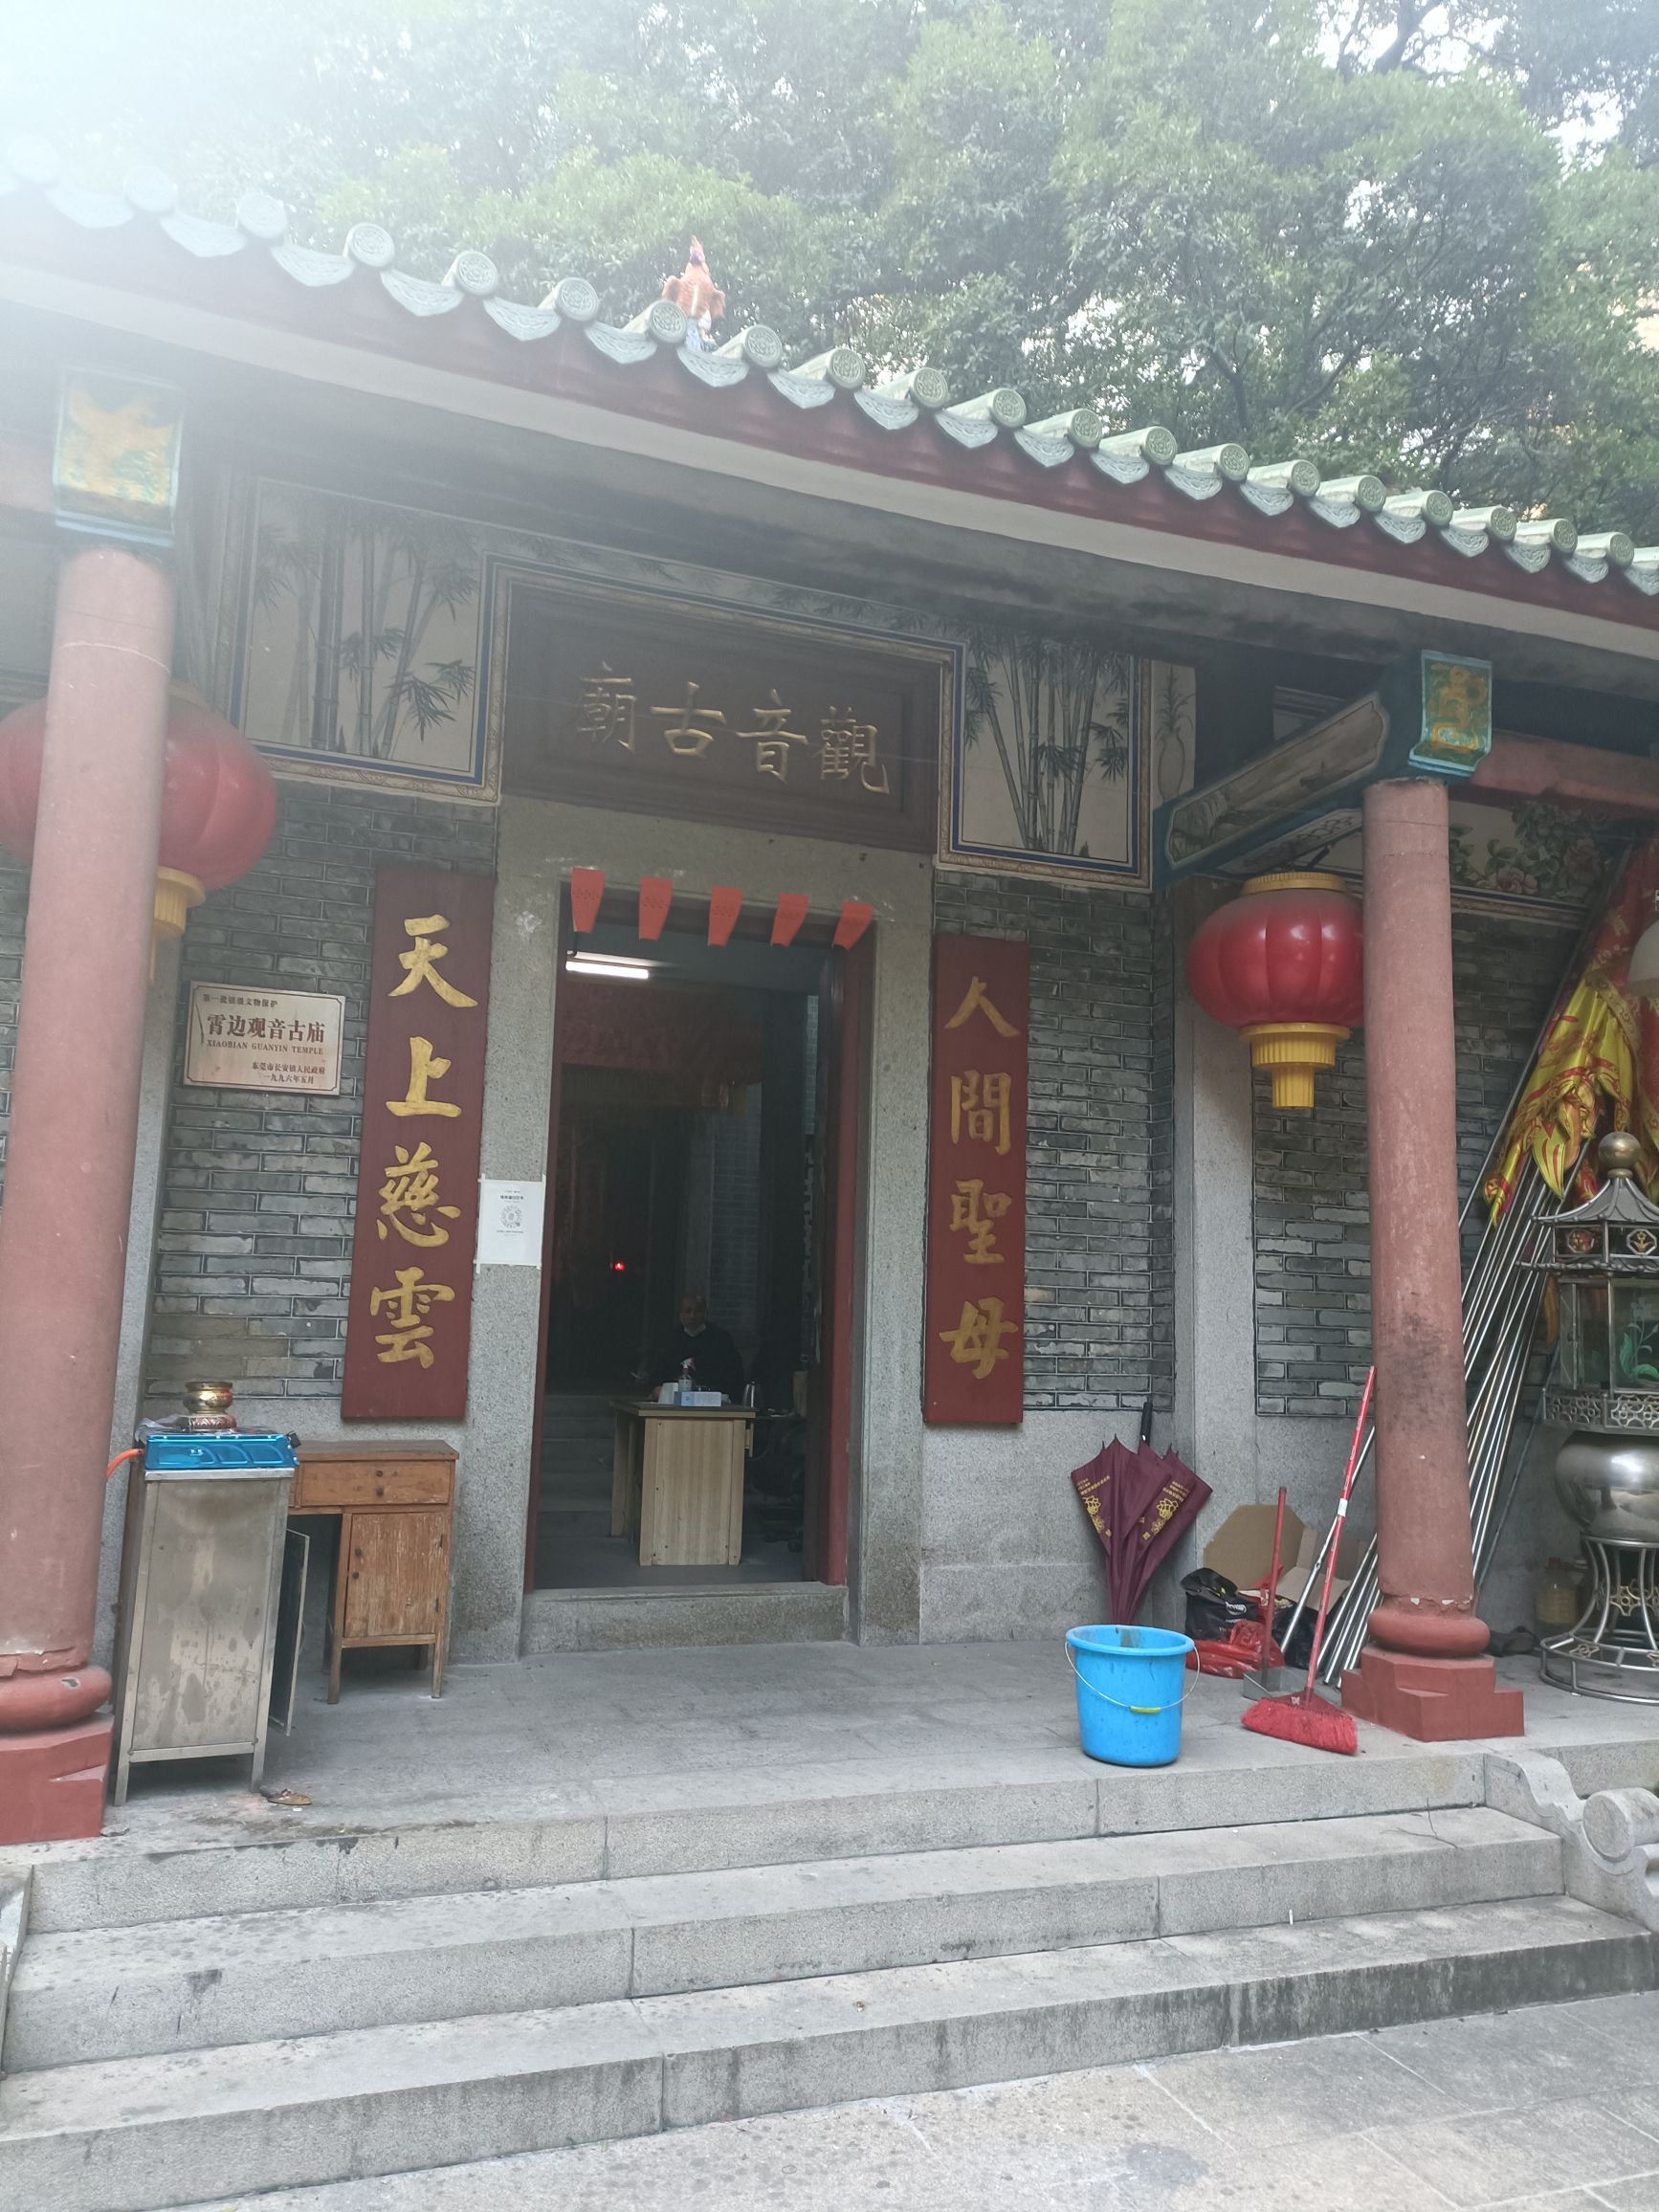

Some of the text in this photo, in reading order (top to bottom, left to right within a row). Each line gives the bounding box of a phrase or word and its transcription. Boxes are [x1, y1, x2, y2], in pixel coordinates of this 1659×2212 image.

[207, 1014, 325, 1043] 霄边观音古庙
[207, 1039, 323, 1055] XIAOBIAN GUANYIN TEMPLE
[252, 1061, 325, 1074] 东莞市长安镇人民政府
[263, 1073, 314, 1084] 一九九六年五月
[370, 914, 478, 1369] 天上慈雲
[939, 975, 1021, 1379] 人間聖母
